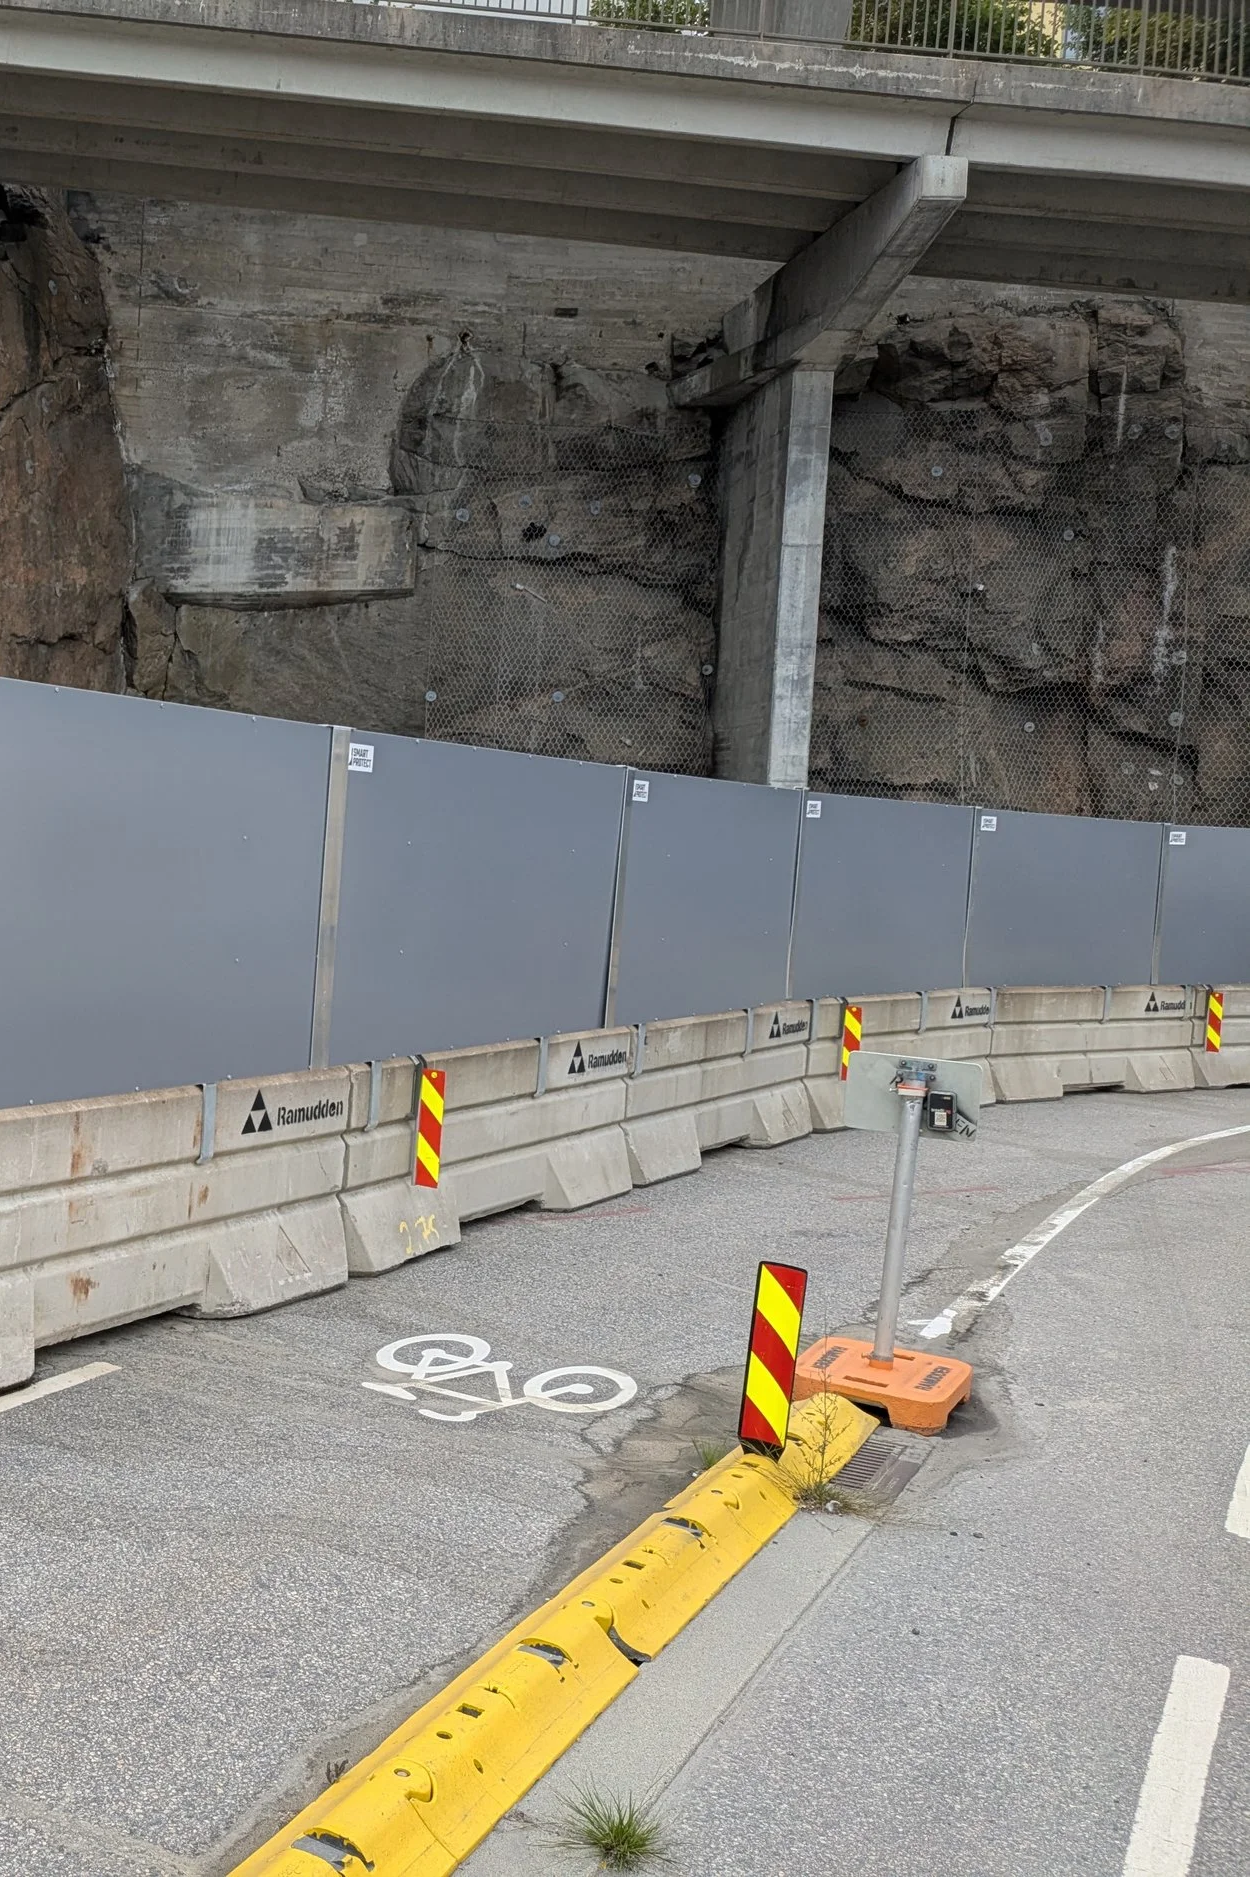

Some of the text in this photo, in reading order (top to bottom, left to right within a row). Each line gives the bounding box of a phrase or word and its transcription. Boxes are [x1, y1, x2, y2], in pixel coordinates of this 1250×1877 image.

[353, 747, 369, 758] SMART
[352, 757, 372, 768] PROTECT
[588, 1049, 627, 1069] Ramudden
[277, 1099, 343, 1126] Ramudden
